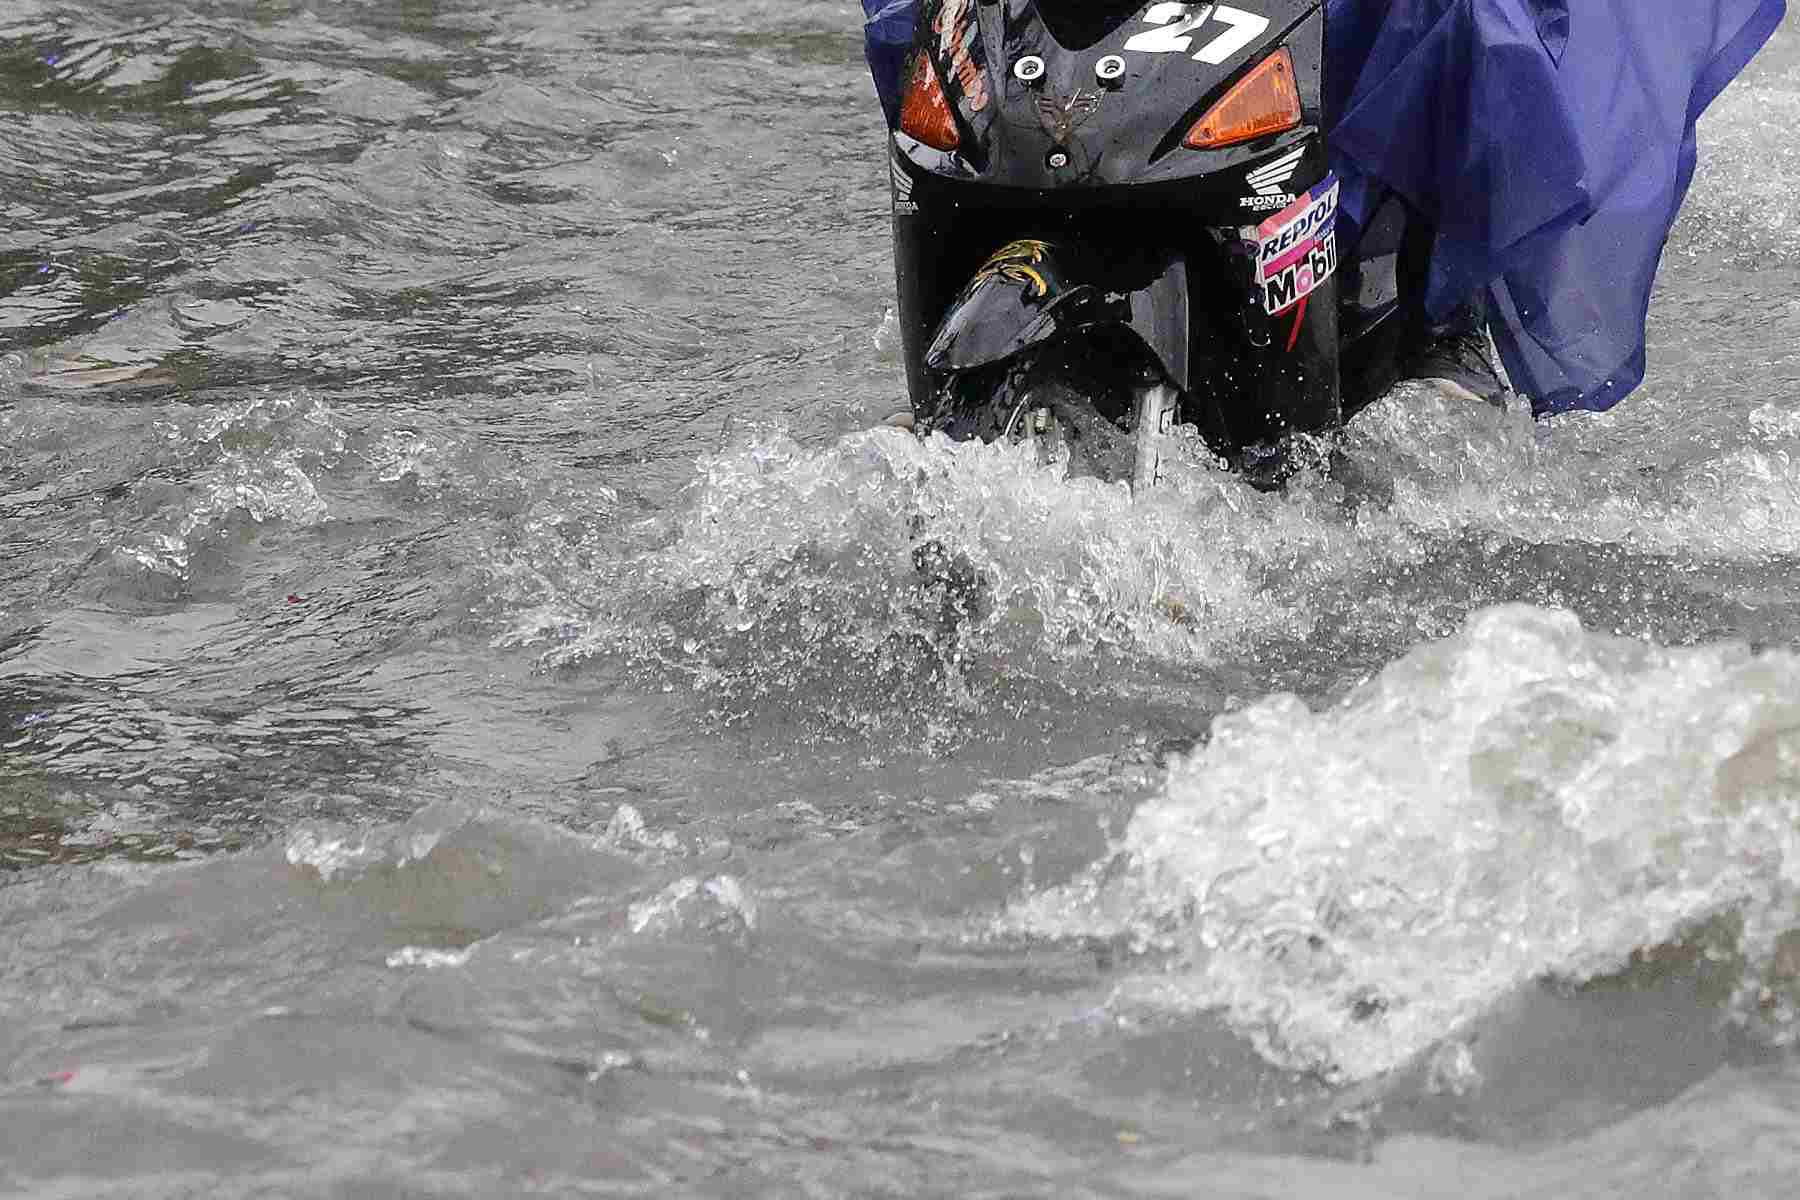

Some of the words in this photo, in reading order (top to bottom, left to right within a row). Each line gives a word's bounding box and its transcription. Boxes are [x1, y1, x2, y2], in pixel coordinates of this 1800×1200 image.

[1123, 0, 1270, 65] 27
[1240, 193, 1297, 207] HONDA
[1265, 236, 1336, 312] Mobil
